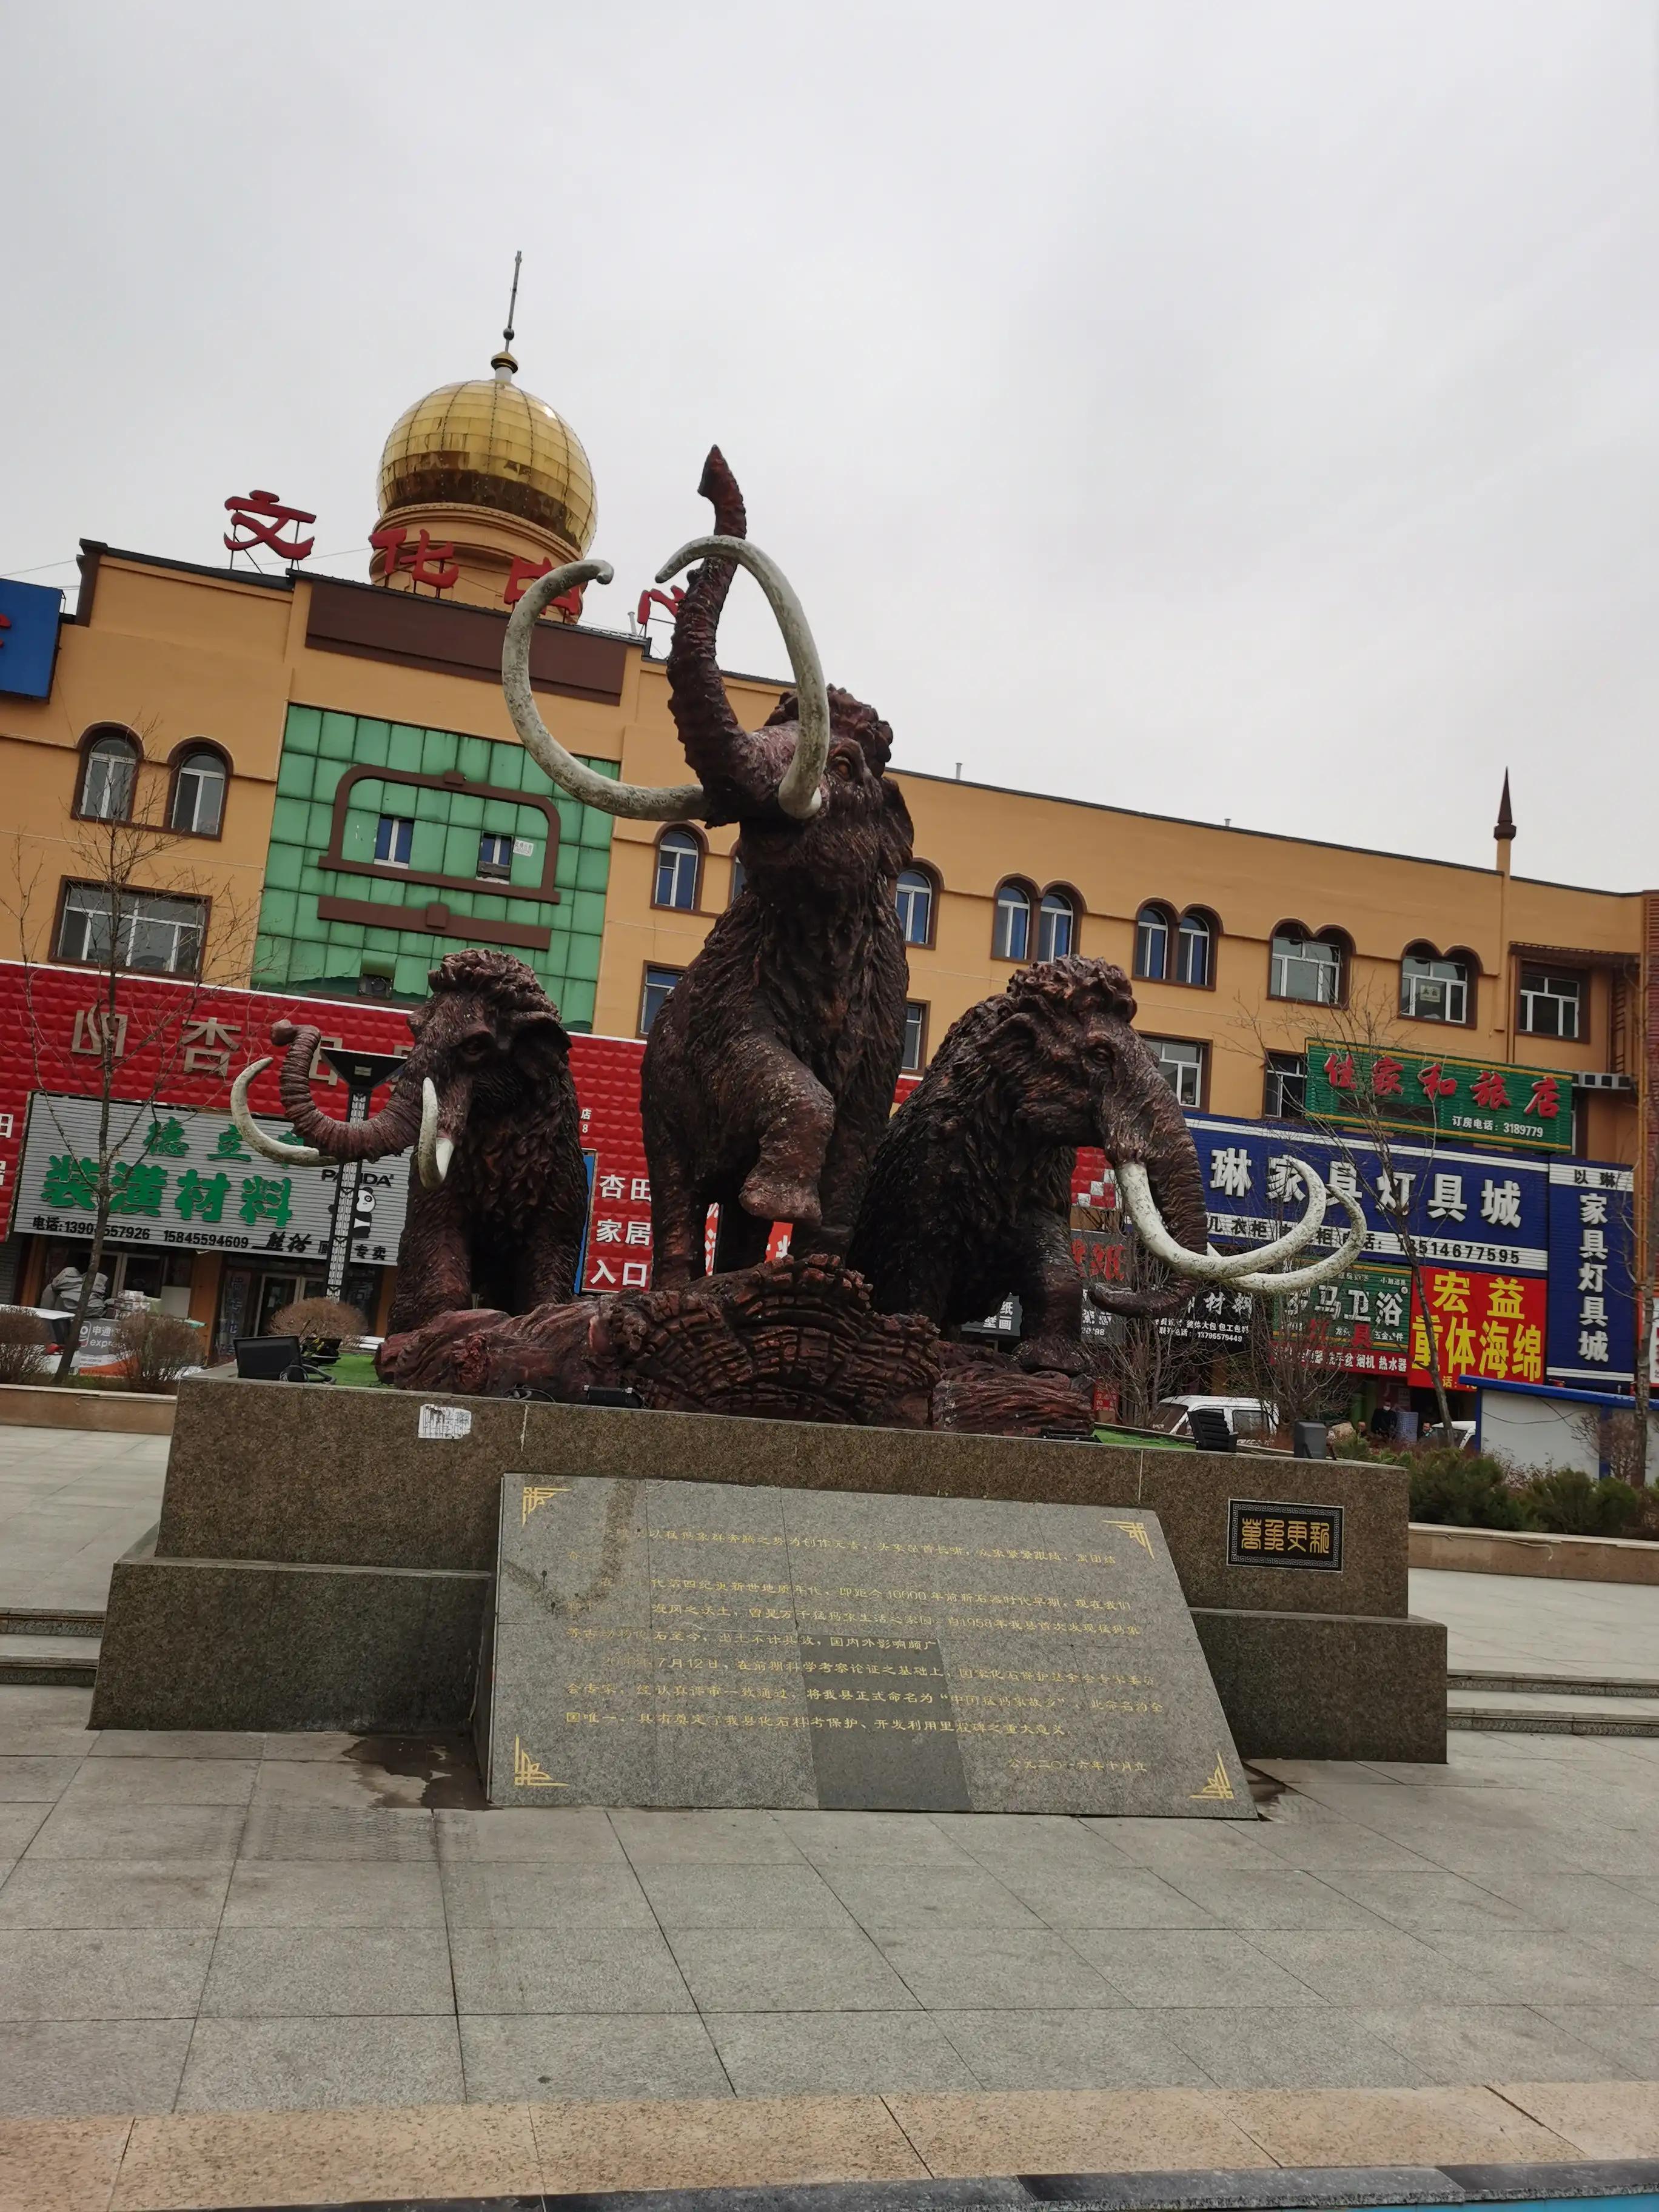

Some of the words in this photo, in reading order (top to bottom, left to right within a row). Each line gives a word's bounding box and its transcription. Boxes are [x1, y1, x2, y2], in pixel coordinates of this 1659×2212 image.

[143, 1116, 305, 1170] 德立
[40, 1155, 293, 1229] 装潢材料
[321, 1168, 392, 1188] PADA
[599, 1174, 651, 1202] 杏田
[32, 1215, 151, 1241] 电话:1390557926
[595, 1218, 651, 1246] 家居
[589, 1258, 648, 1287] 入口
[1578, 1193, 1609, 1363] 家具灯具城
[1432, 1271, 1525, 1320] 宏益
[1378, 1355, 1407, 1373] 热水器
